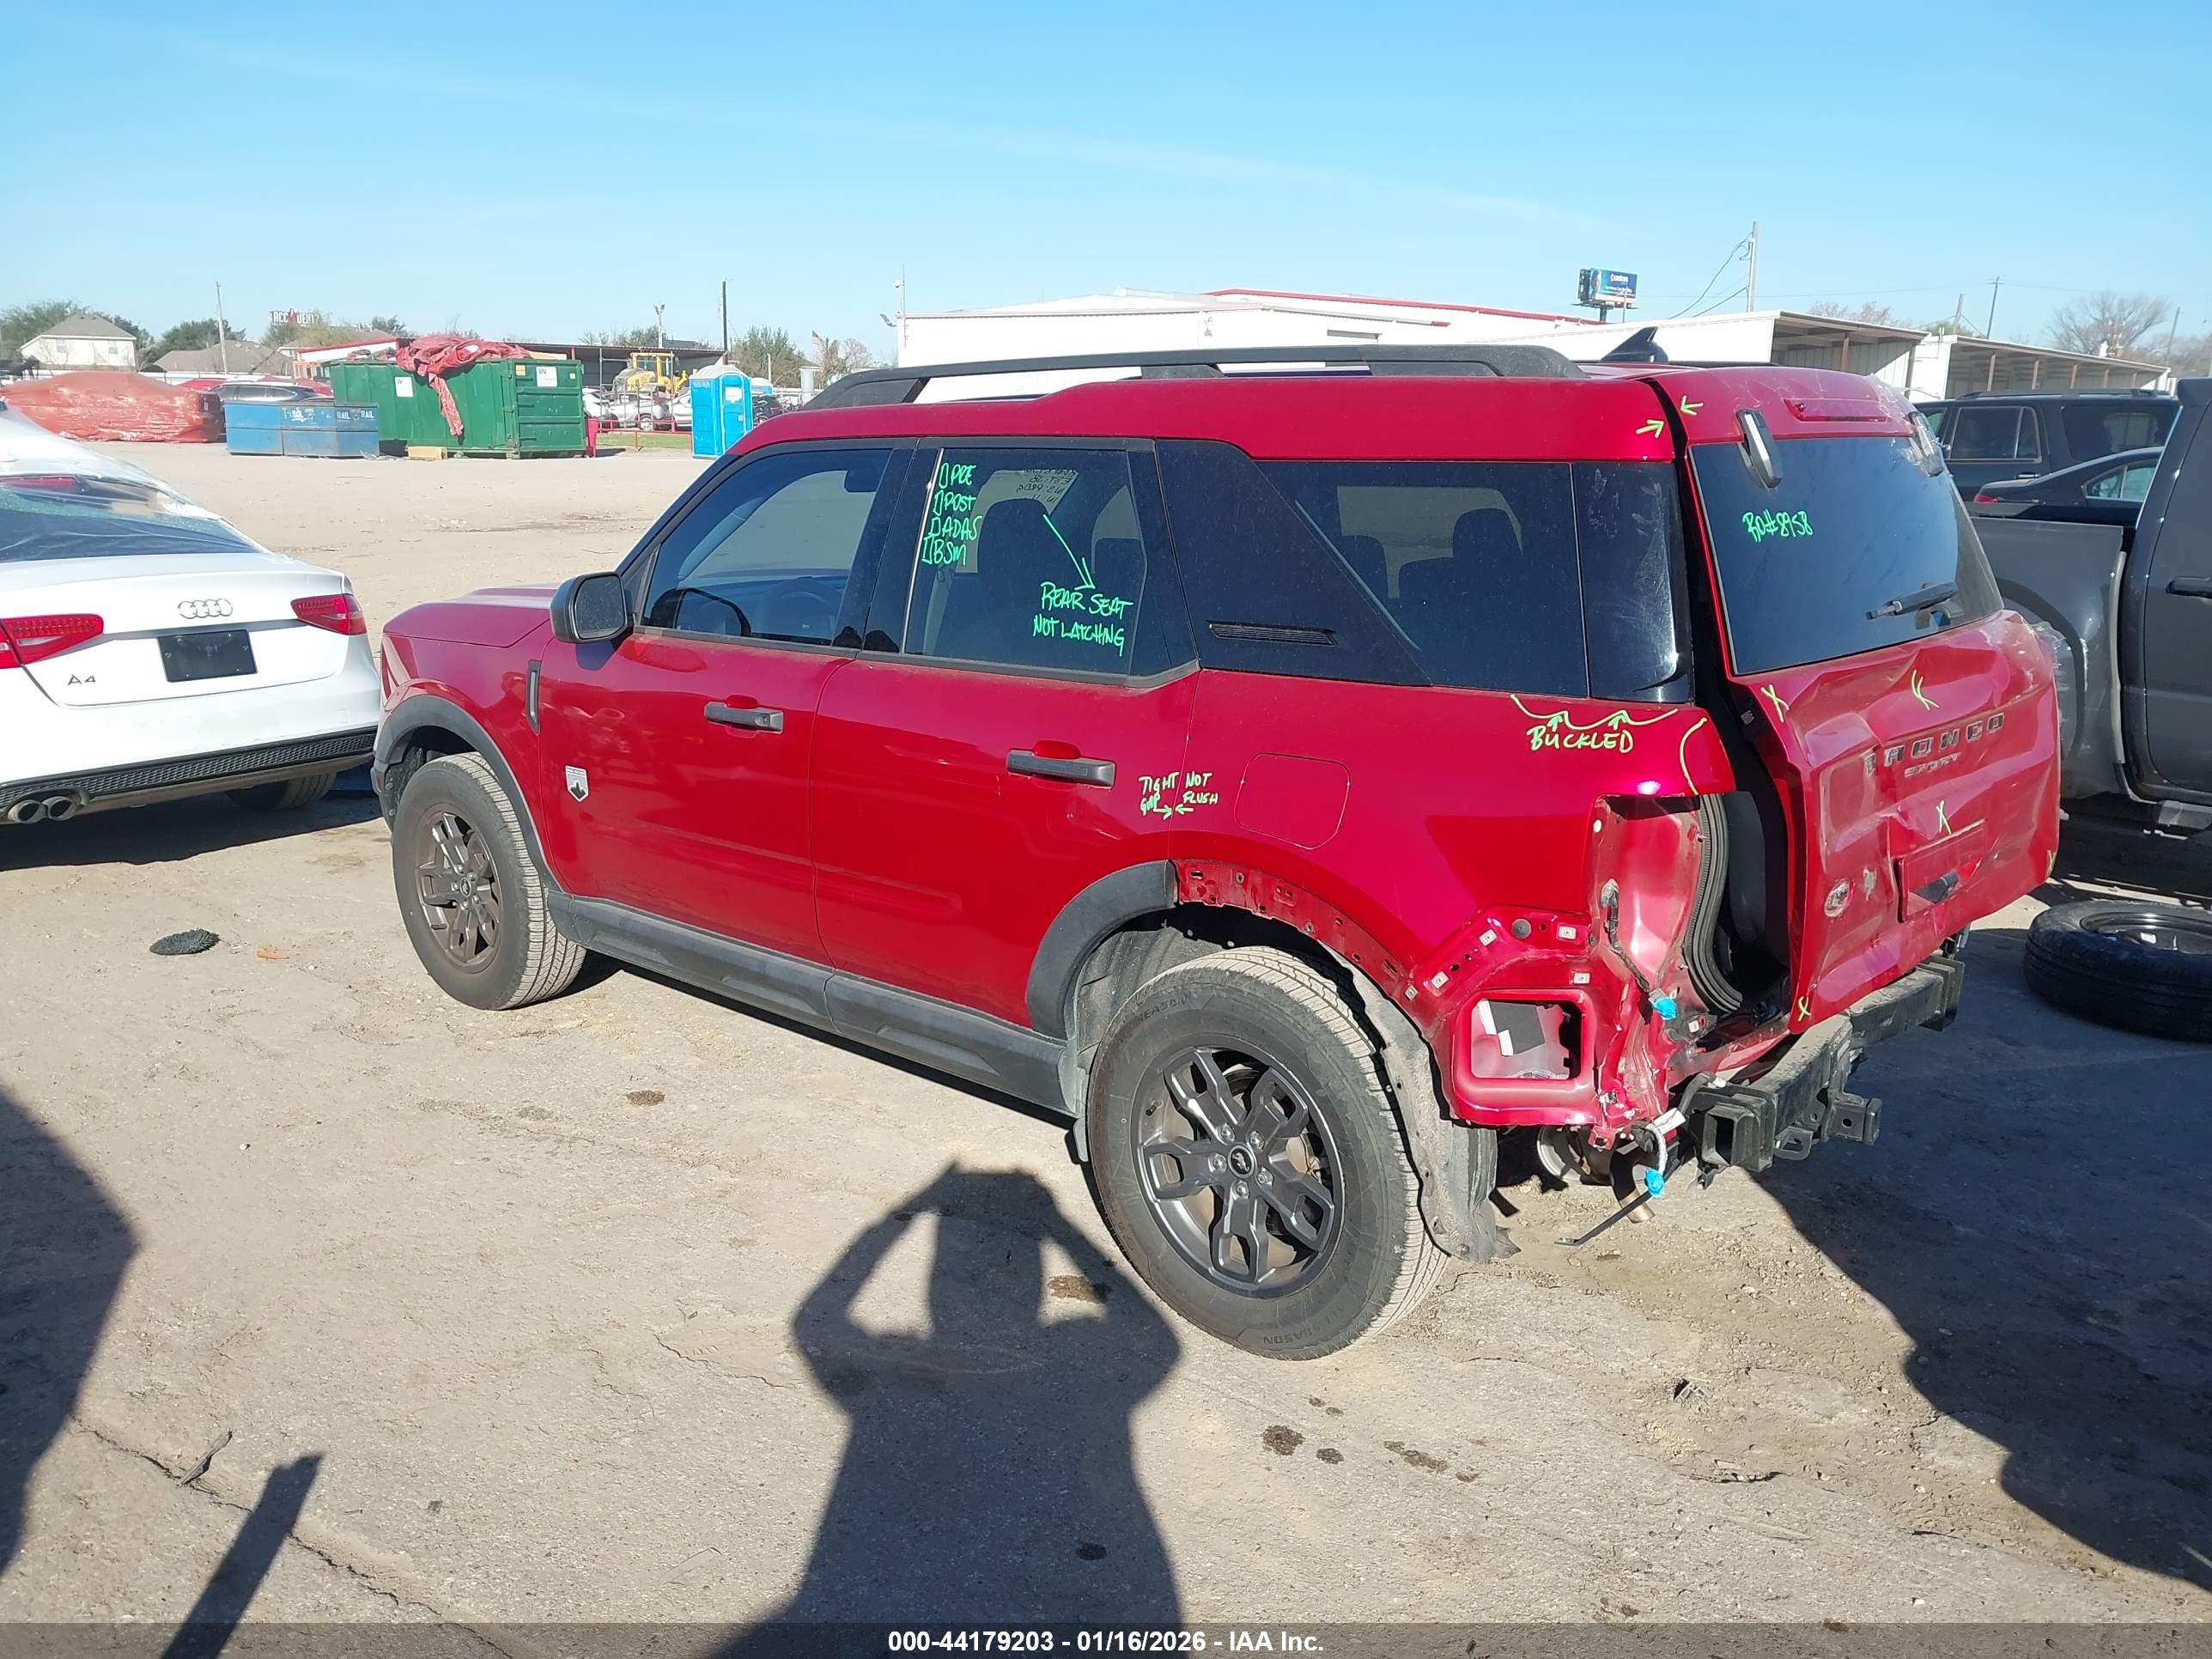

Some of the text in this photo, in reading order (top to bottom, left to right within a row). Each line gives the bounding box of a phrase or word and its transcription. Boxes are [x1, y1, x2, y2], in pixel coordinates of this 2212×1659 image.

[944, 491, 976, 512] POST
[941, 515, 982, 540] ADAS
[933, 538, 966, 566] BSM
[1040, 580, 1134, 620] REAR SEAT
[1032, 613, 1125, 657] NOT LATCHING
[67, 673, 96, 686] A4
[1526, 725, 1634, 754] BUCKLED
[1138, 771, 1180, 795] TIGHT
[1185, 770, 1212, 789] NOT
[1182, 790, 1218, 805] FLUSH
